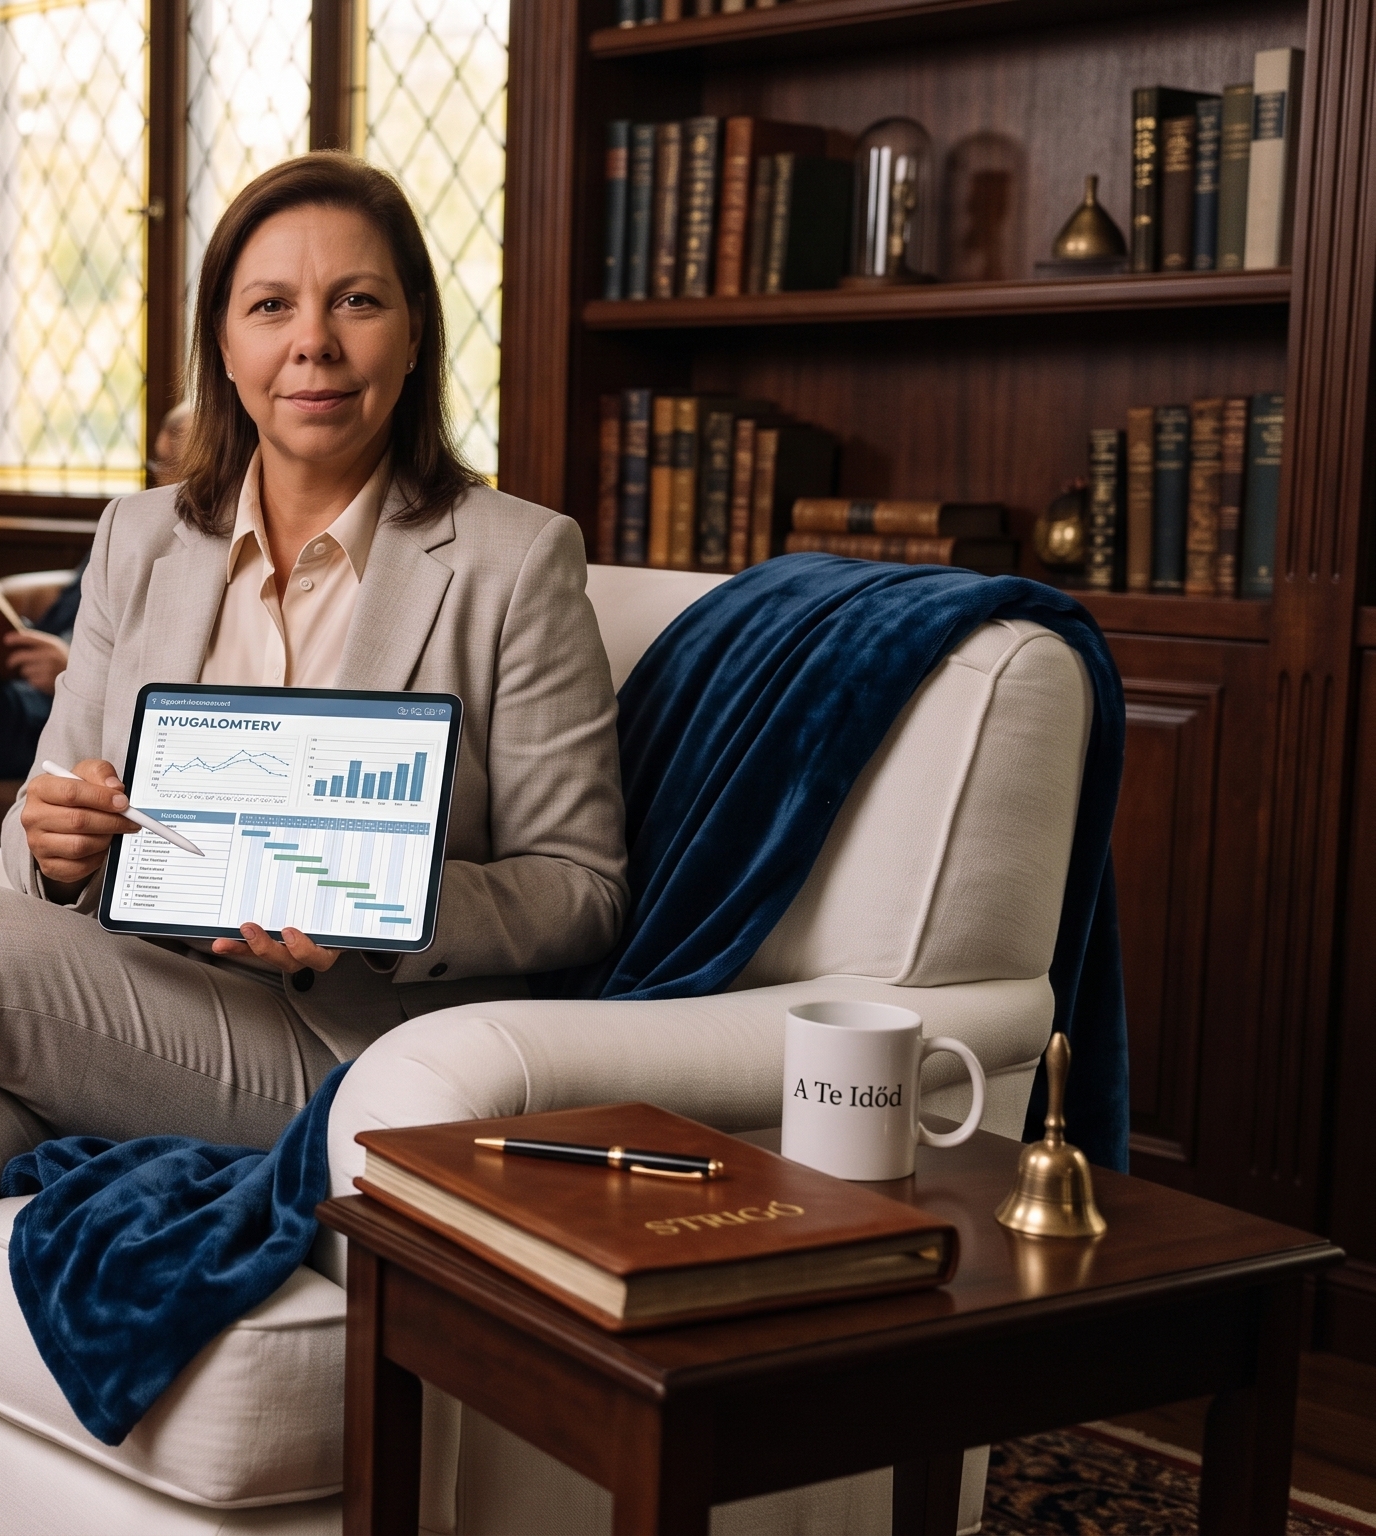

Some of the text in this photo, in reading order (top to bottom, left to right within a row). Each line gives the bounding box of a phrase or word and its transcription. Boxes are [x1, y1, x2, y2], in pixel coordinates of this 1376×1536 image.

[157, 715, 282, 732] NYUGALOMTERV
[793, 1078, 902, 1108] A Te Időd
